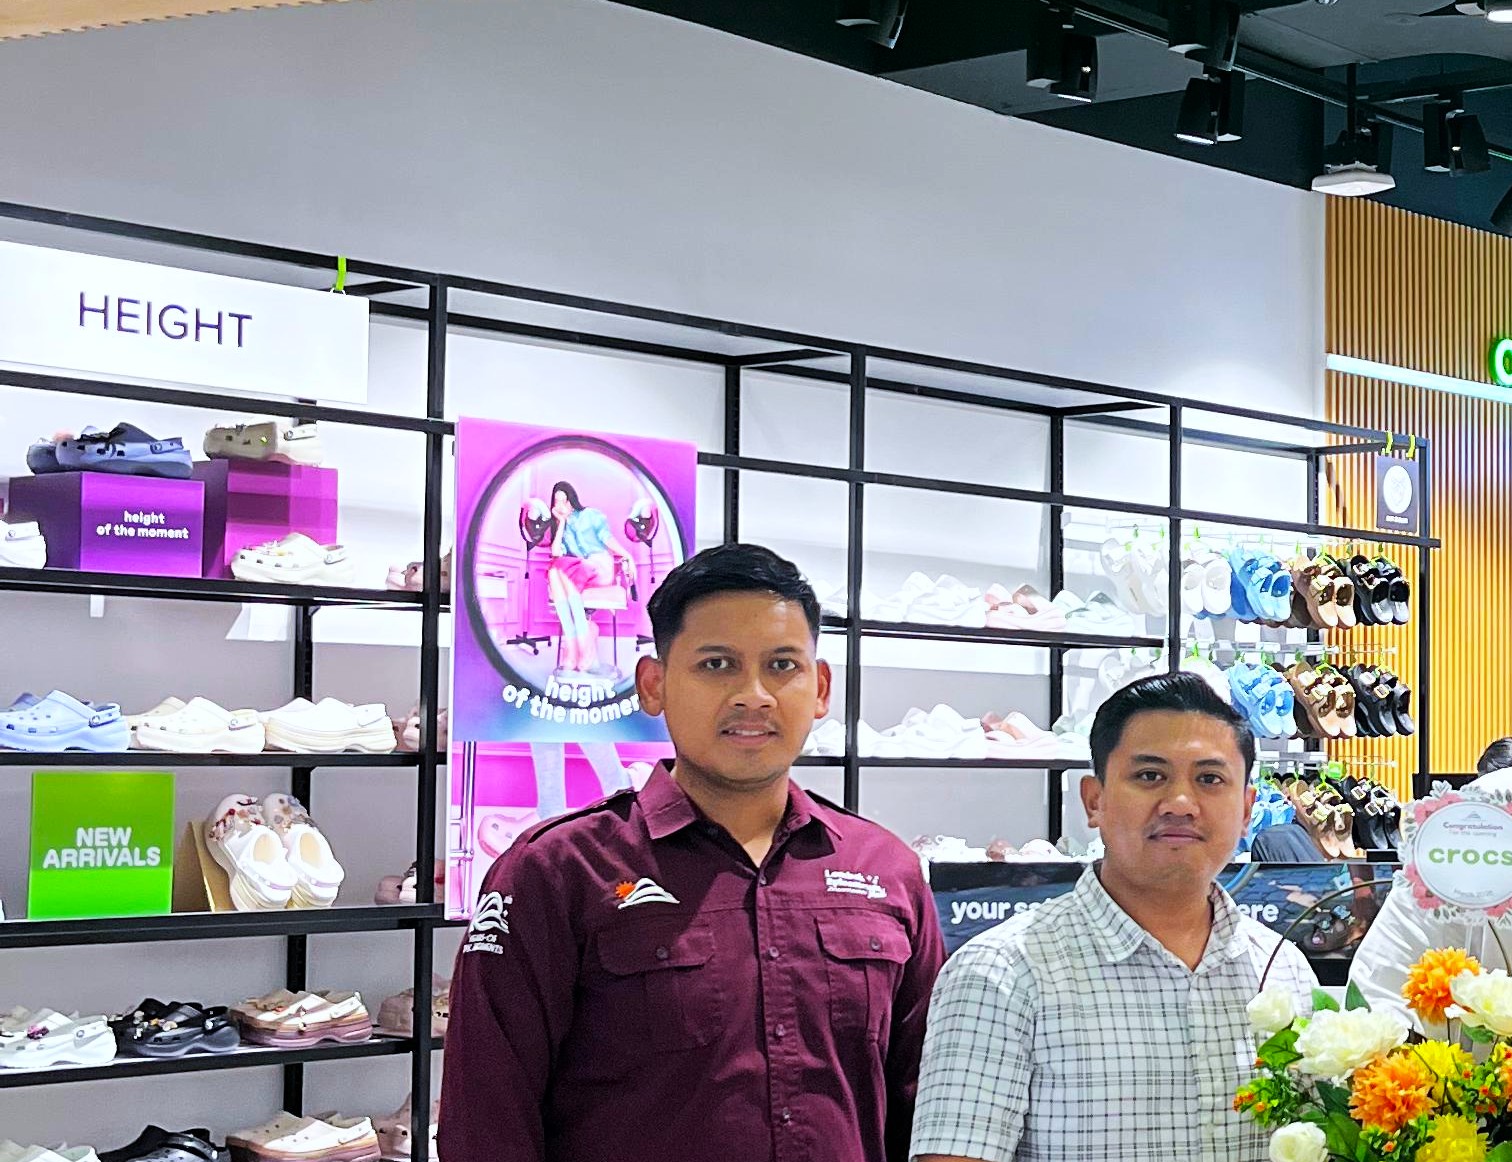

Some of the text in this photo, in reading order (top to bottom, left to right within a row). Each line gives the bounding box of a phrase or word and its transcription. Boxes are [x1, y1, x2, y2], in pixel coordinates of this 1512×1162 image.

[79, 291, 253, 348] HEIGHT
[123, 510, 165, 526] height
[96, 523, 189, 539] of the moment
[545, 675, 616, 707] height
[502, 684, 531, 708] of
[530, 694, 567, 723] the
[76, 826, 132, 847] NEW
[42, 846, 161, 869] ARRIVALS
[951, 901, 1011, 924] your
